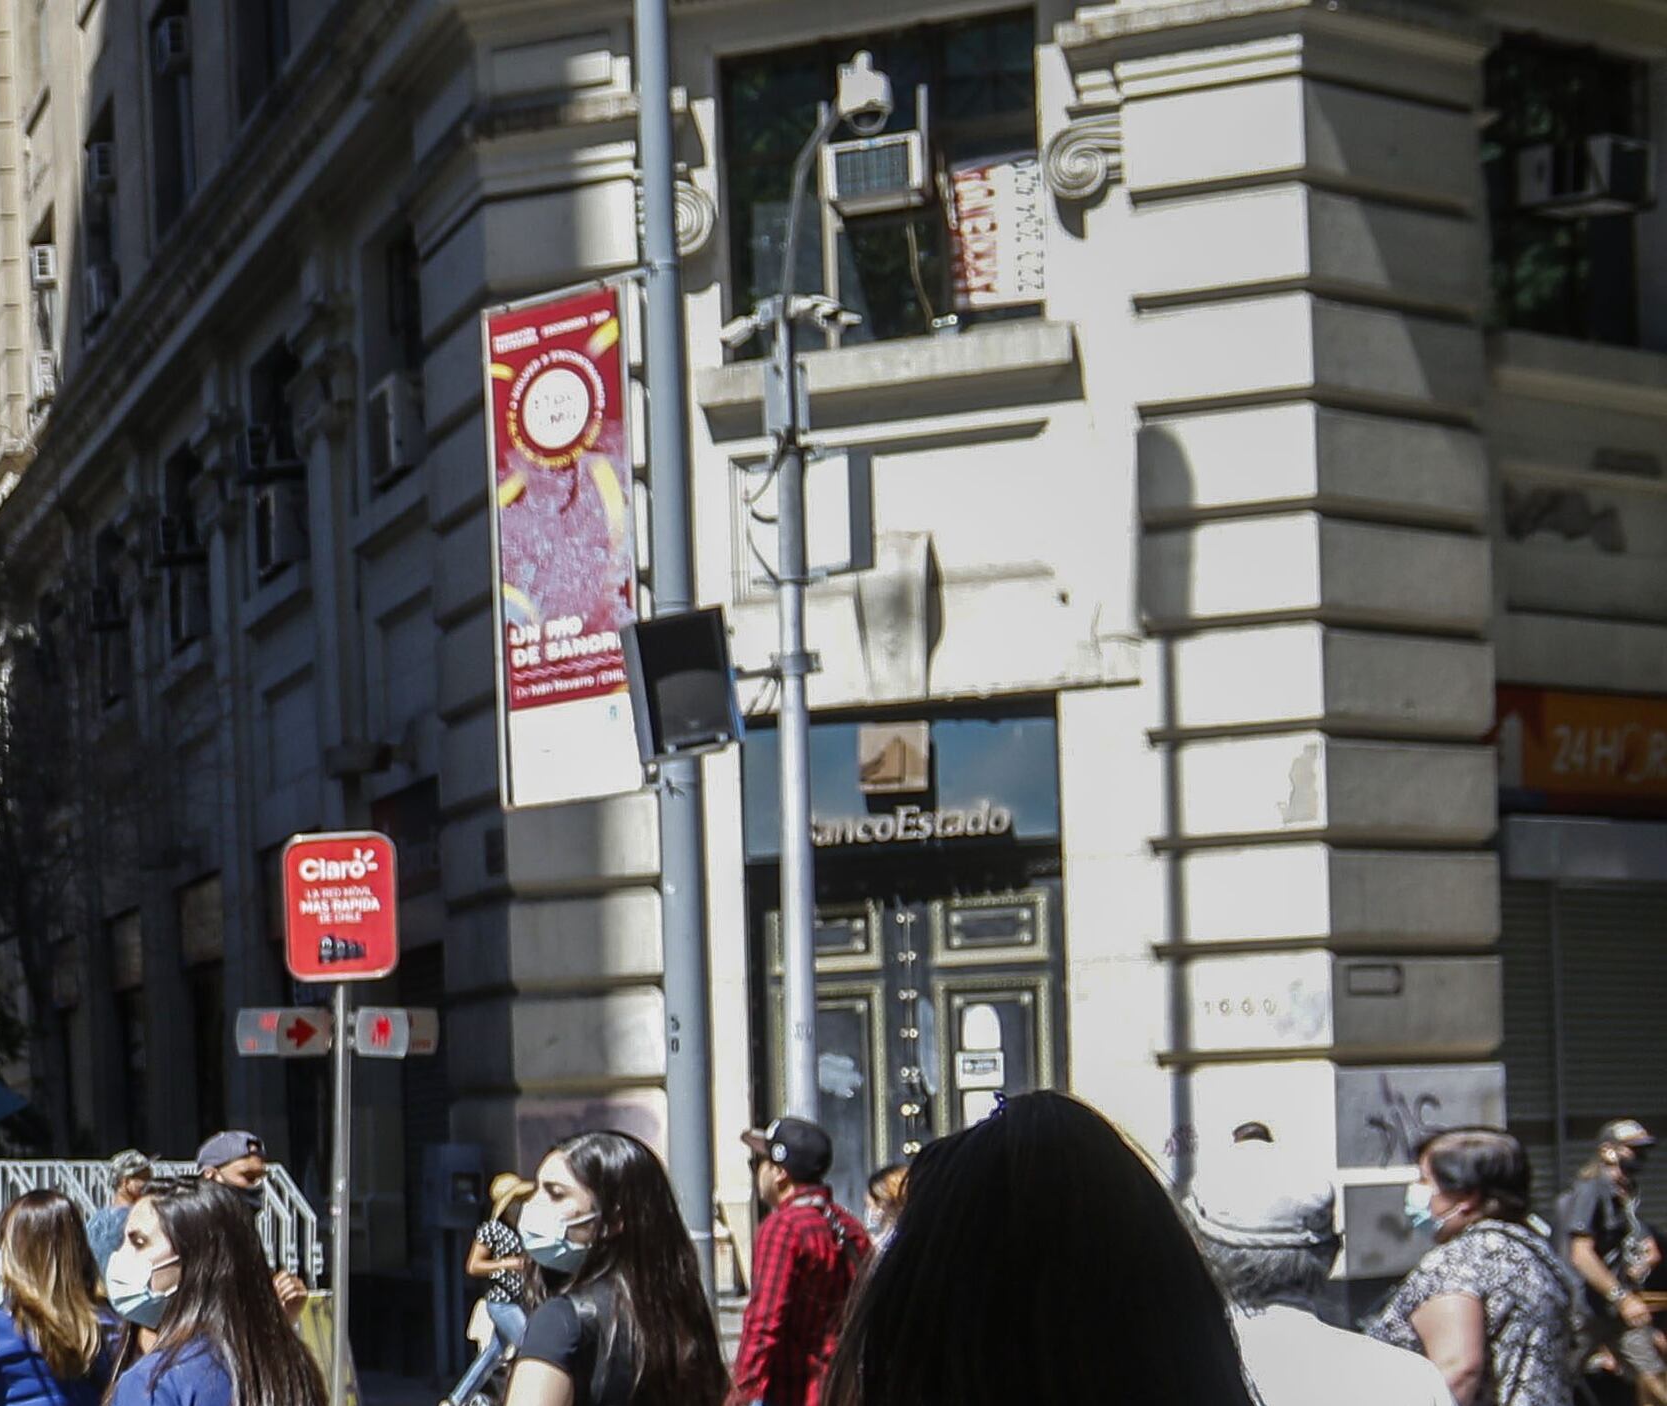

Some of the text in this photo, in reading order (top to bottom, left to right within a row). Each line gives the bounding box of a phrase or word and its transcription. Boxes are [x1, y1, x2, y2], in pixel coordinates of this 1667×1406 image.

[509, 624, 541, 646] UN
[511, 631, 623, 668] DE SANGR
[299, 854, 369, 881] Claro
